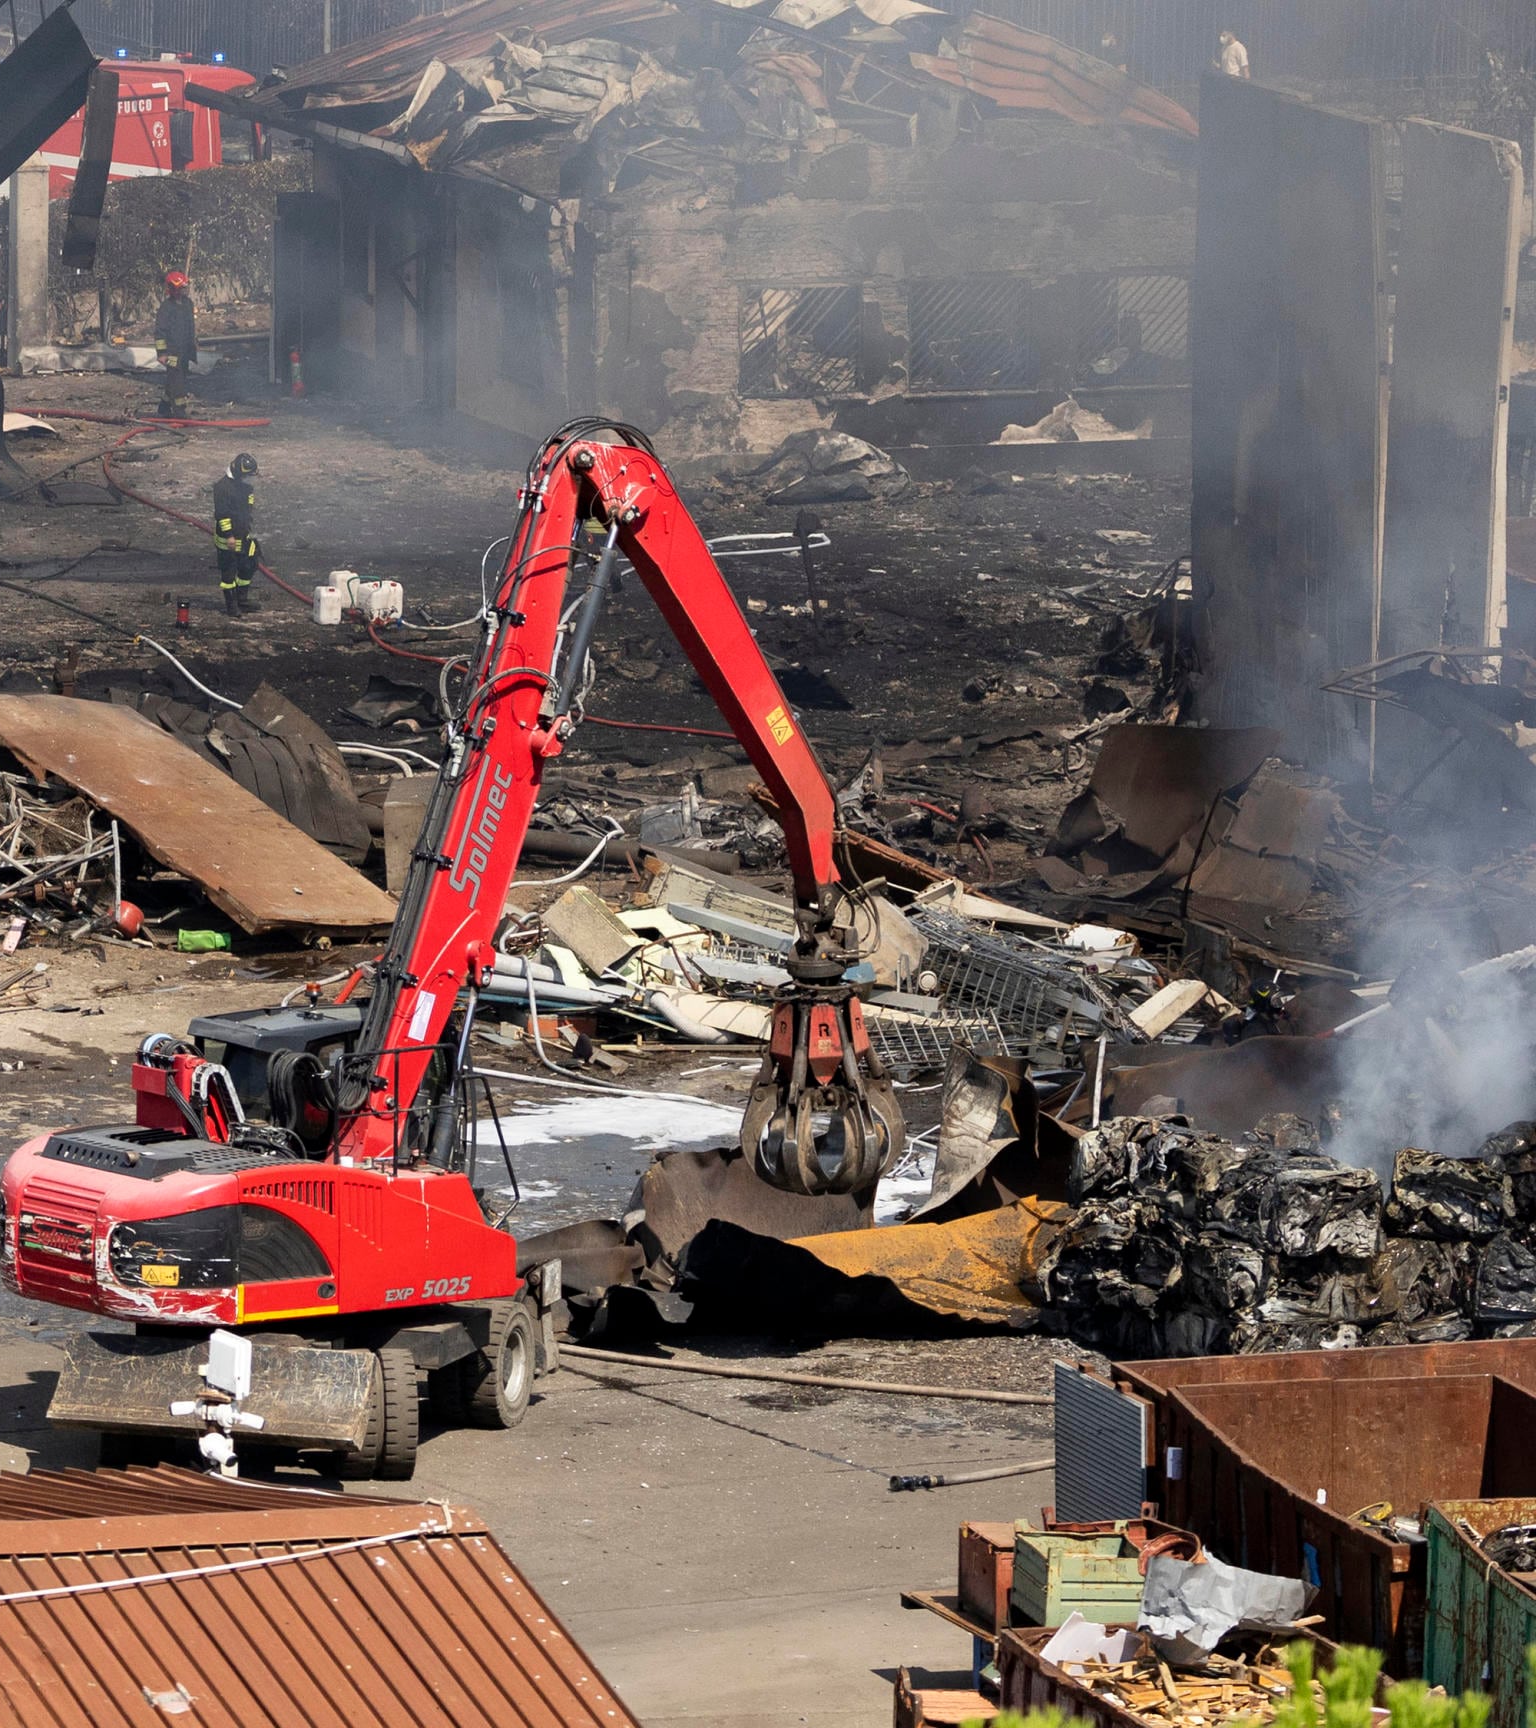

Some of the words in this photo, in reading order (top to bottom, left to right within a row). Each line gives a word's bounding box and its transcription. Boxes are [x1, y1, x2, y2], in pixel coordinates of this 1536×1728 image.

[117, 98, 152, 114] FUOCO
[151, 138, 167, 148] 115
[448, 754, 513, 909] Solmec
[819, 1023, 832, 1037] R
[385, 1287, 415, 1302] EXP
[421, 1276, 472, 1298] 5025
